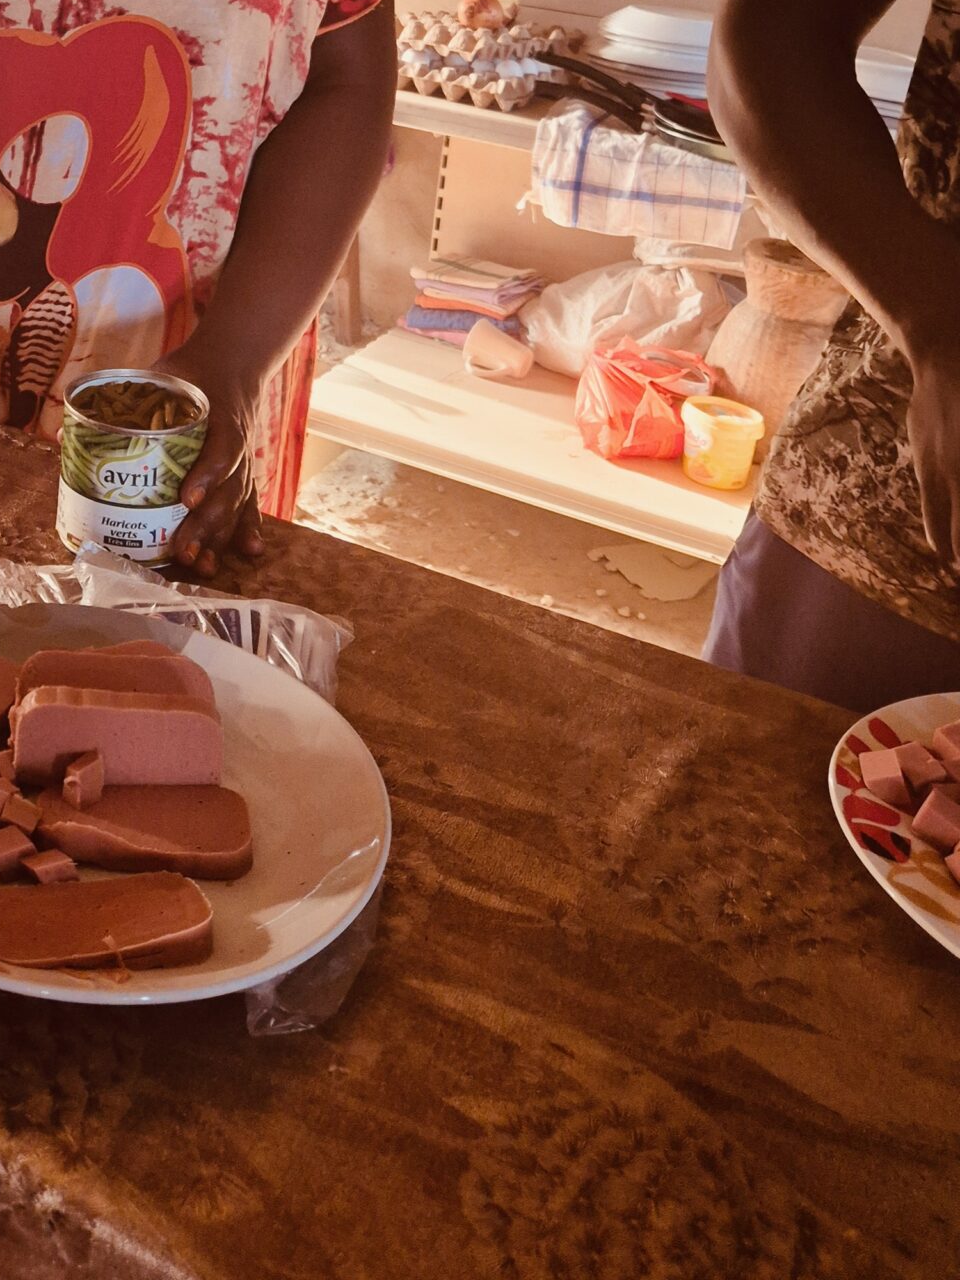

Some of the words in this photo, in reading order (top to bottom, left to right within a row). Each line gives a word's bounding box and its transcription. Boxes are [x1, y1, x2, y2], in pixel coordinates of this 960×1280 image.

[103, 465, 158, 487] avril
[101, 516, 148, 529] Haricots
[110, 529, 138, 539] verts
